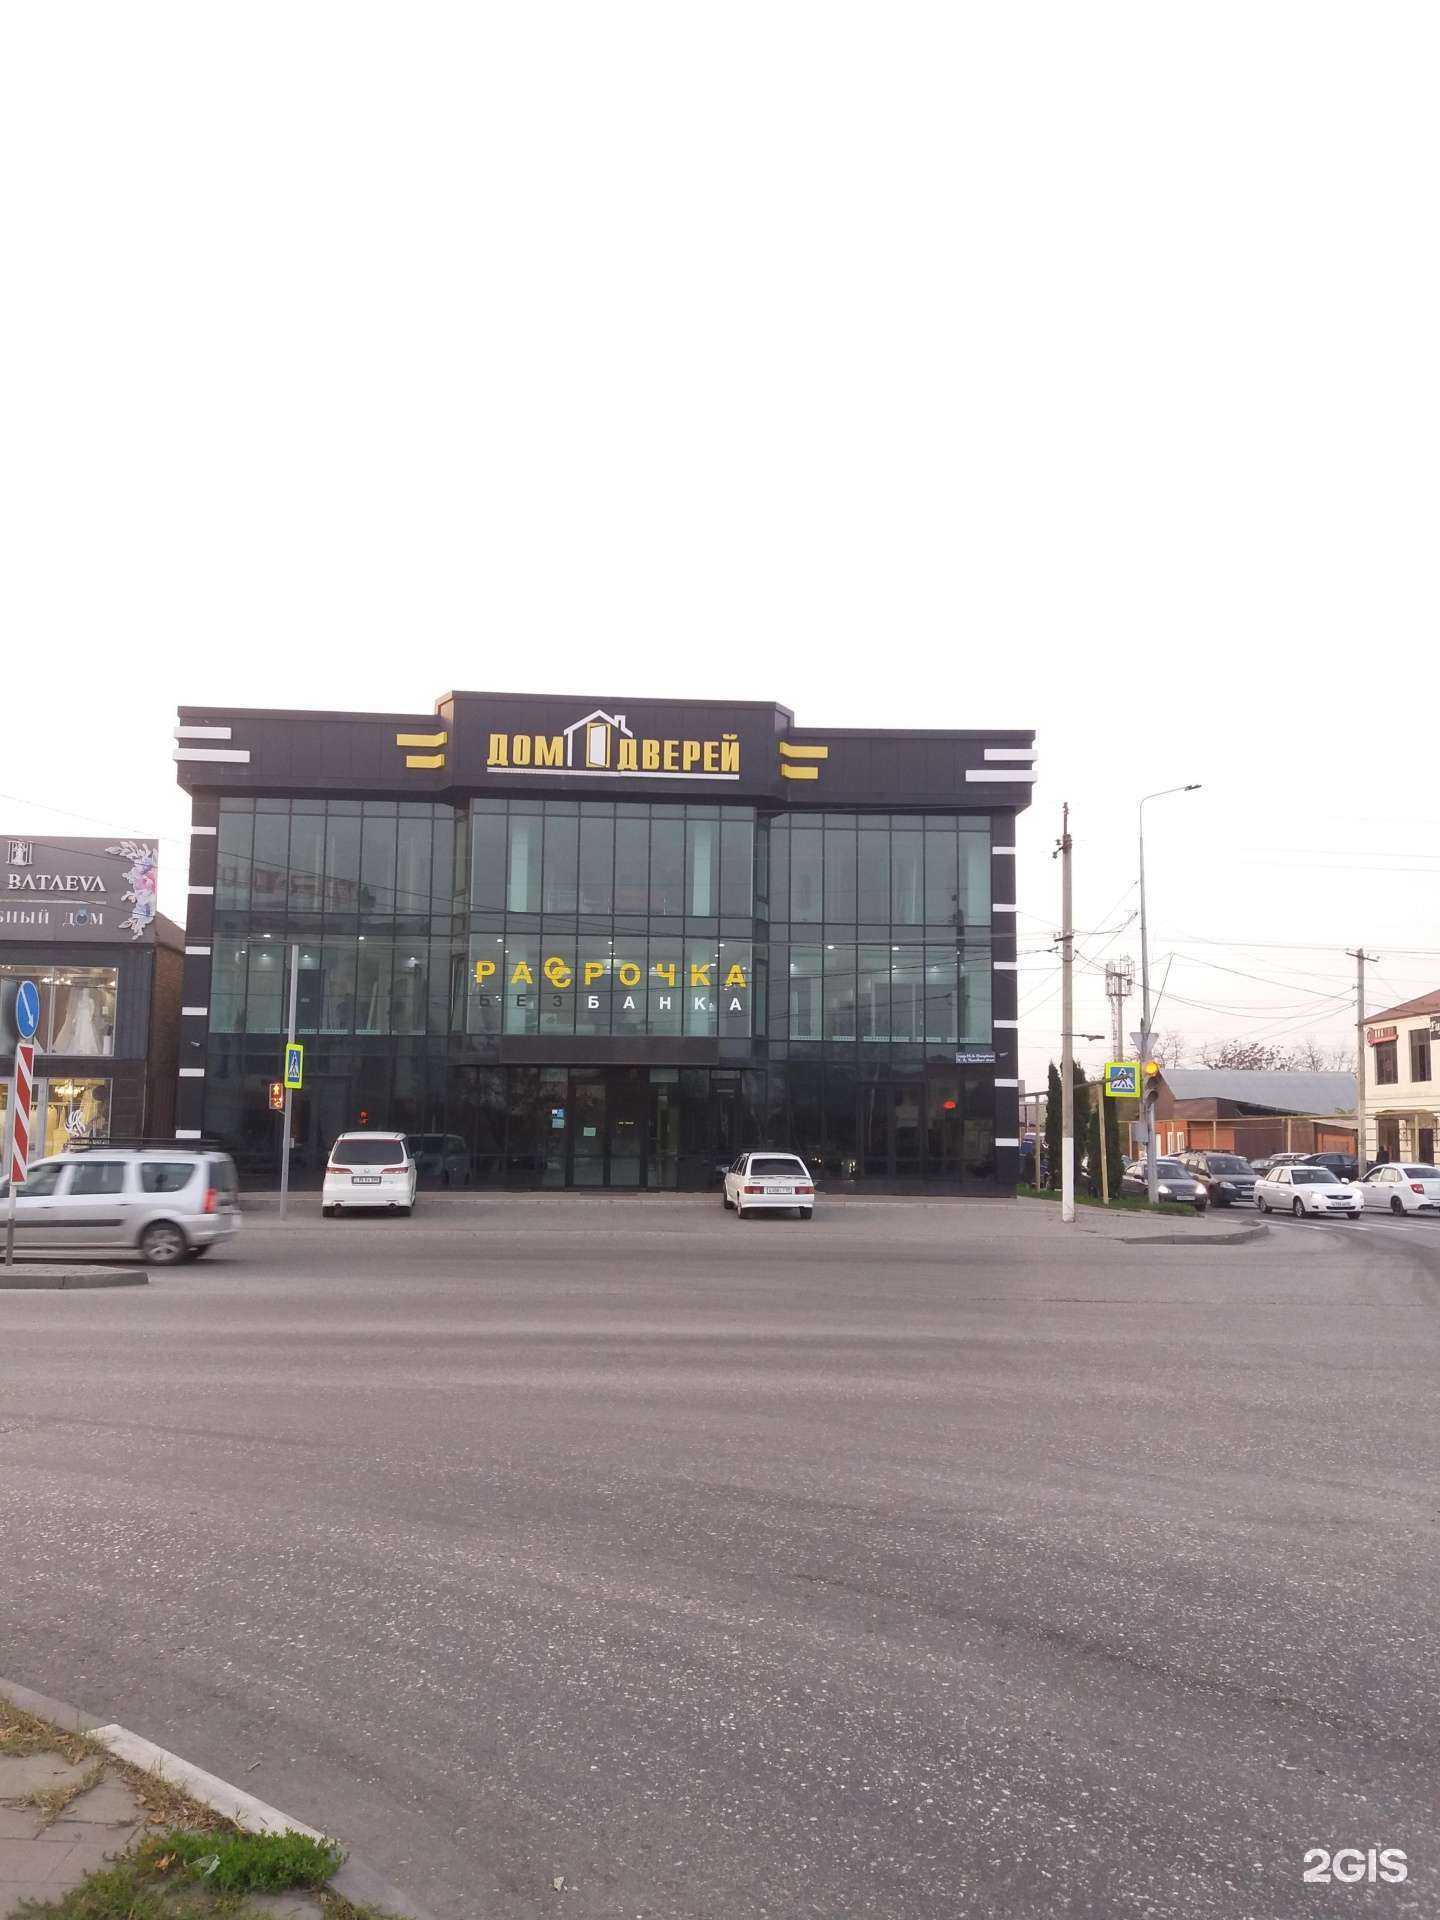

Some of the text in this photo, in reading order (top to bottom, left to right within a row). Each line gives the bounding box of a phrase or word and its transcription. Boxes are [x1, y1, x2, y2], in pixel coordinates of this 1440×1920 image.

[487, 733, 740, 772] ДОМ ДВЕРЕЙ
[8, 873, 107, 892] BATAEVA
[62, 905, 104, 928] ДОМ
[476, 957, 746, 988] РАССРОЧКА
[479, 993, 742, 1011] БЕЗ БАНКА
